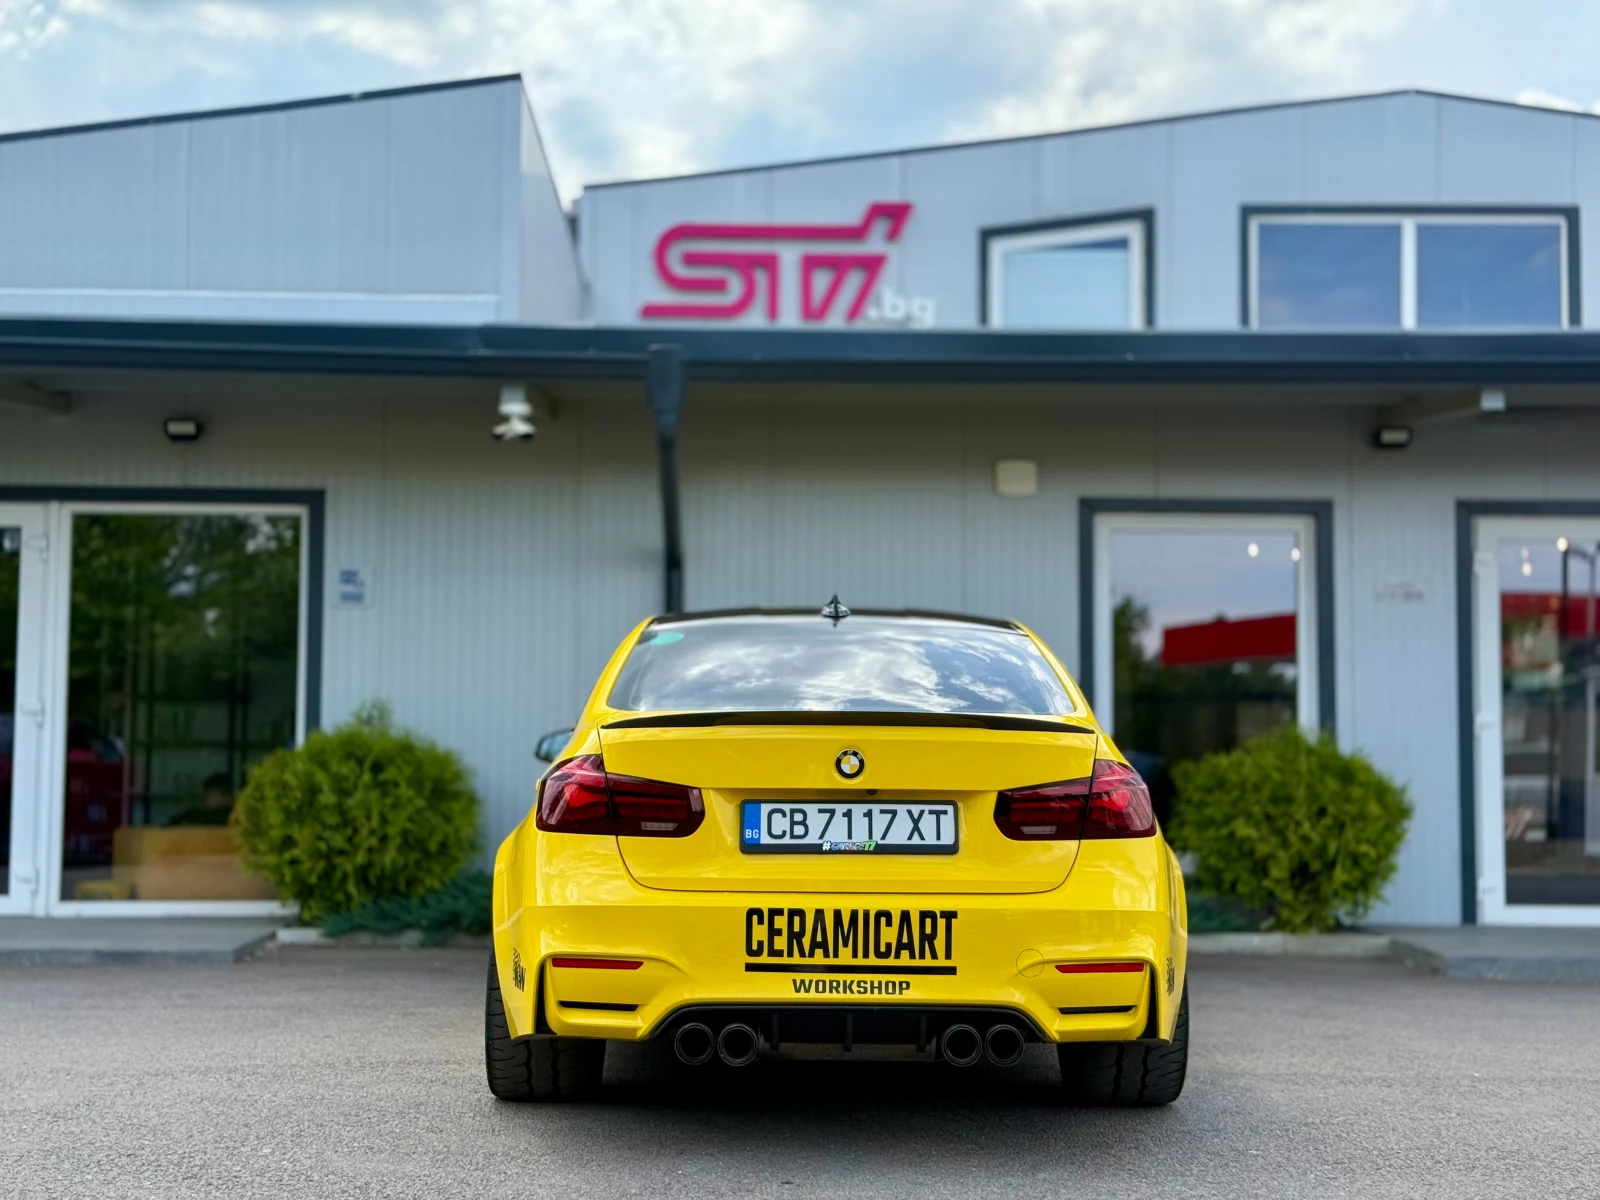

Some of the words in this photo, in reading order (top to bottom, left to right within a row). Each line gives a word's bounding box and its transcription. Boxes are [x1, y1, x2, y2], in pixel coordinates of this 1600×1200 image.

[745, 829, 759, 839] BG
[745, 907, 958, 960] CERAMICART
[792, 978, 911, 995] WORKSHOP
